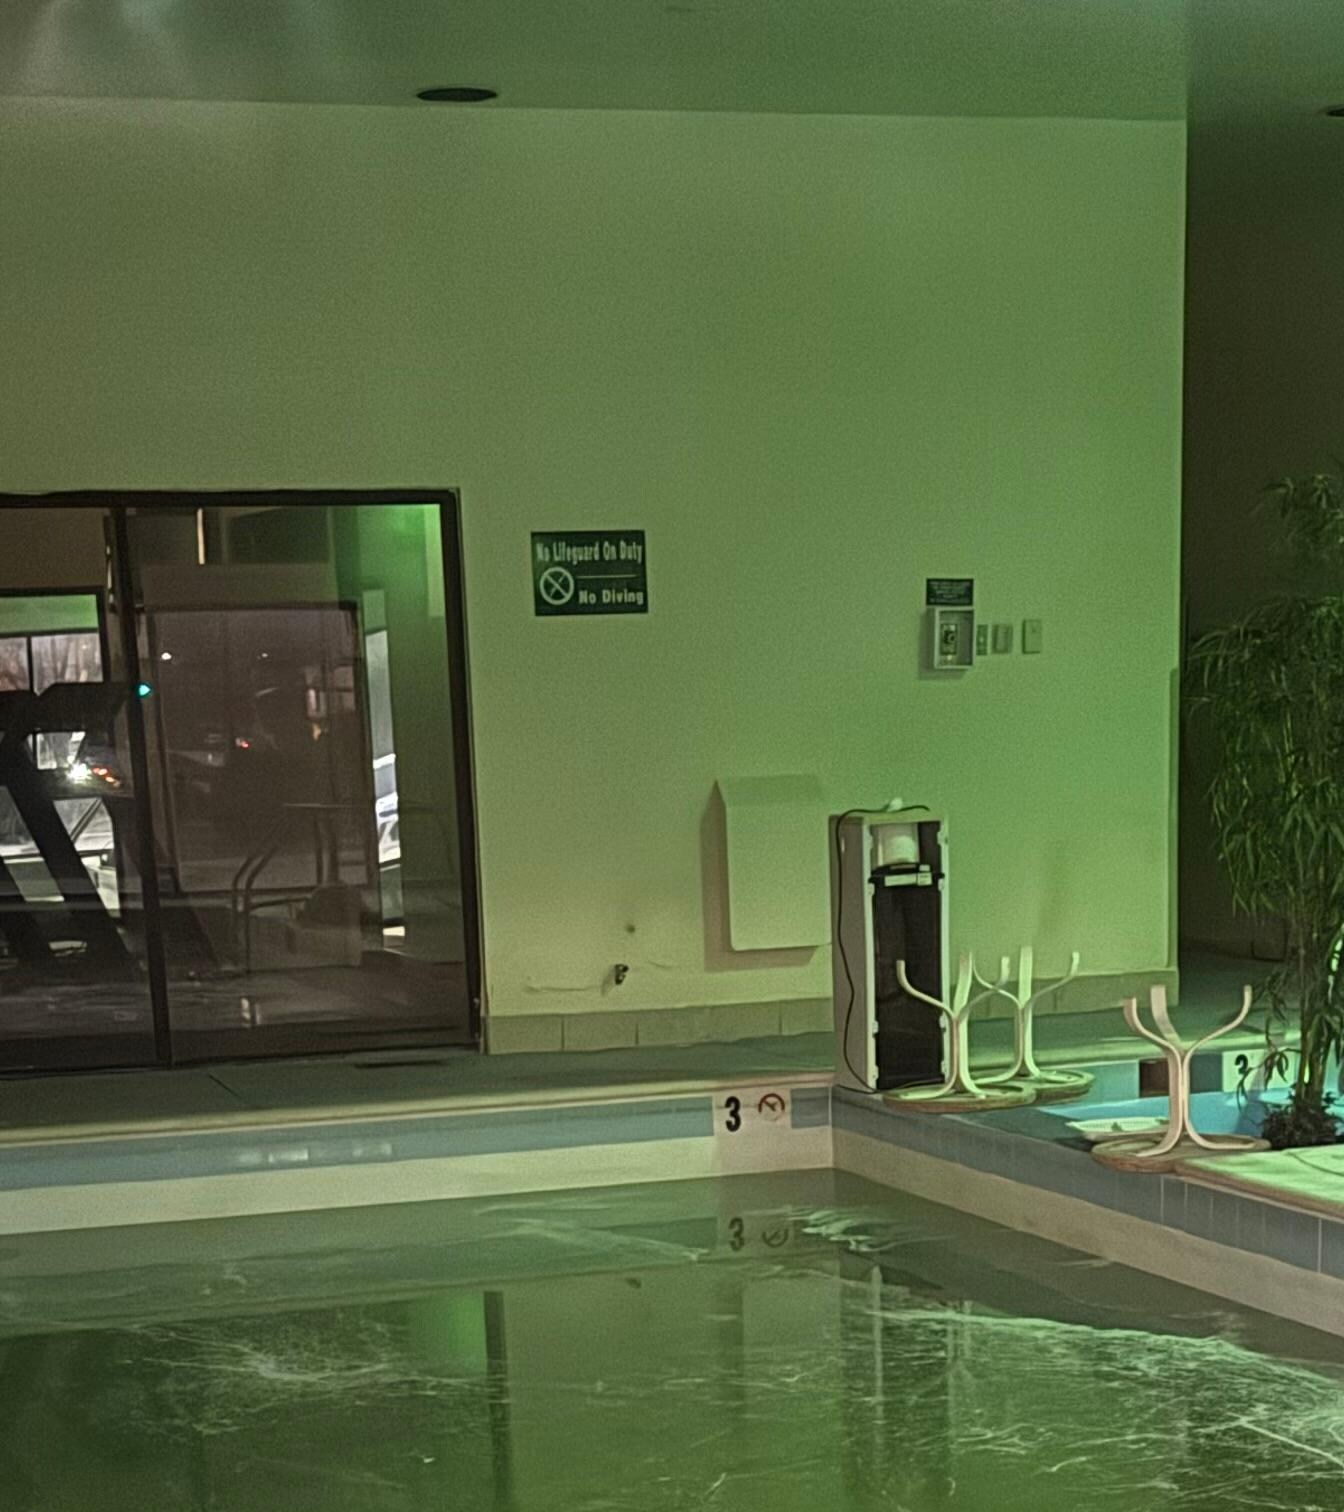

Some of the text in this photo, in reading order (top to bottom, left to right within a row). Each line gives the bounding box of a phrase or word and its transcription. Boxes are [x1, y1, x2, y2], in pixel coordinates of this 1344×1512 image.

[536, 540, 643, 565] No Lifeguard On Duty
[578, 588, 644, 605] No Diving
[725, 1095, 742, 1132] 3
